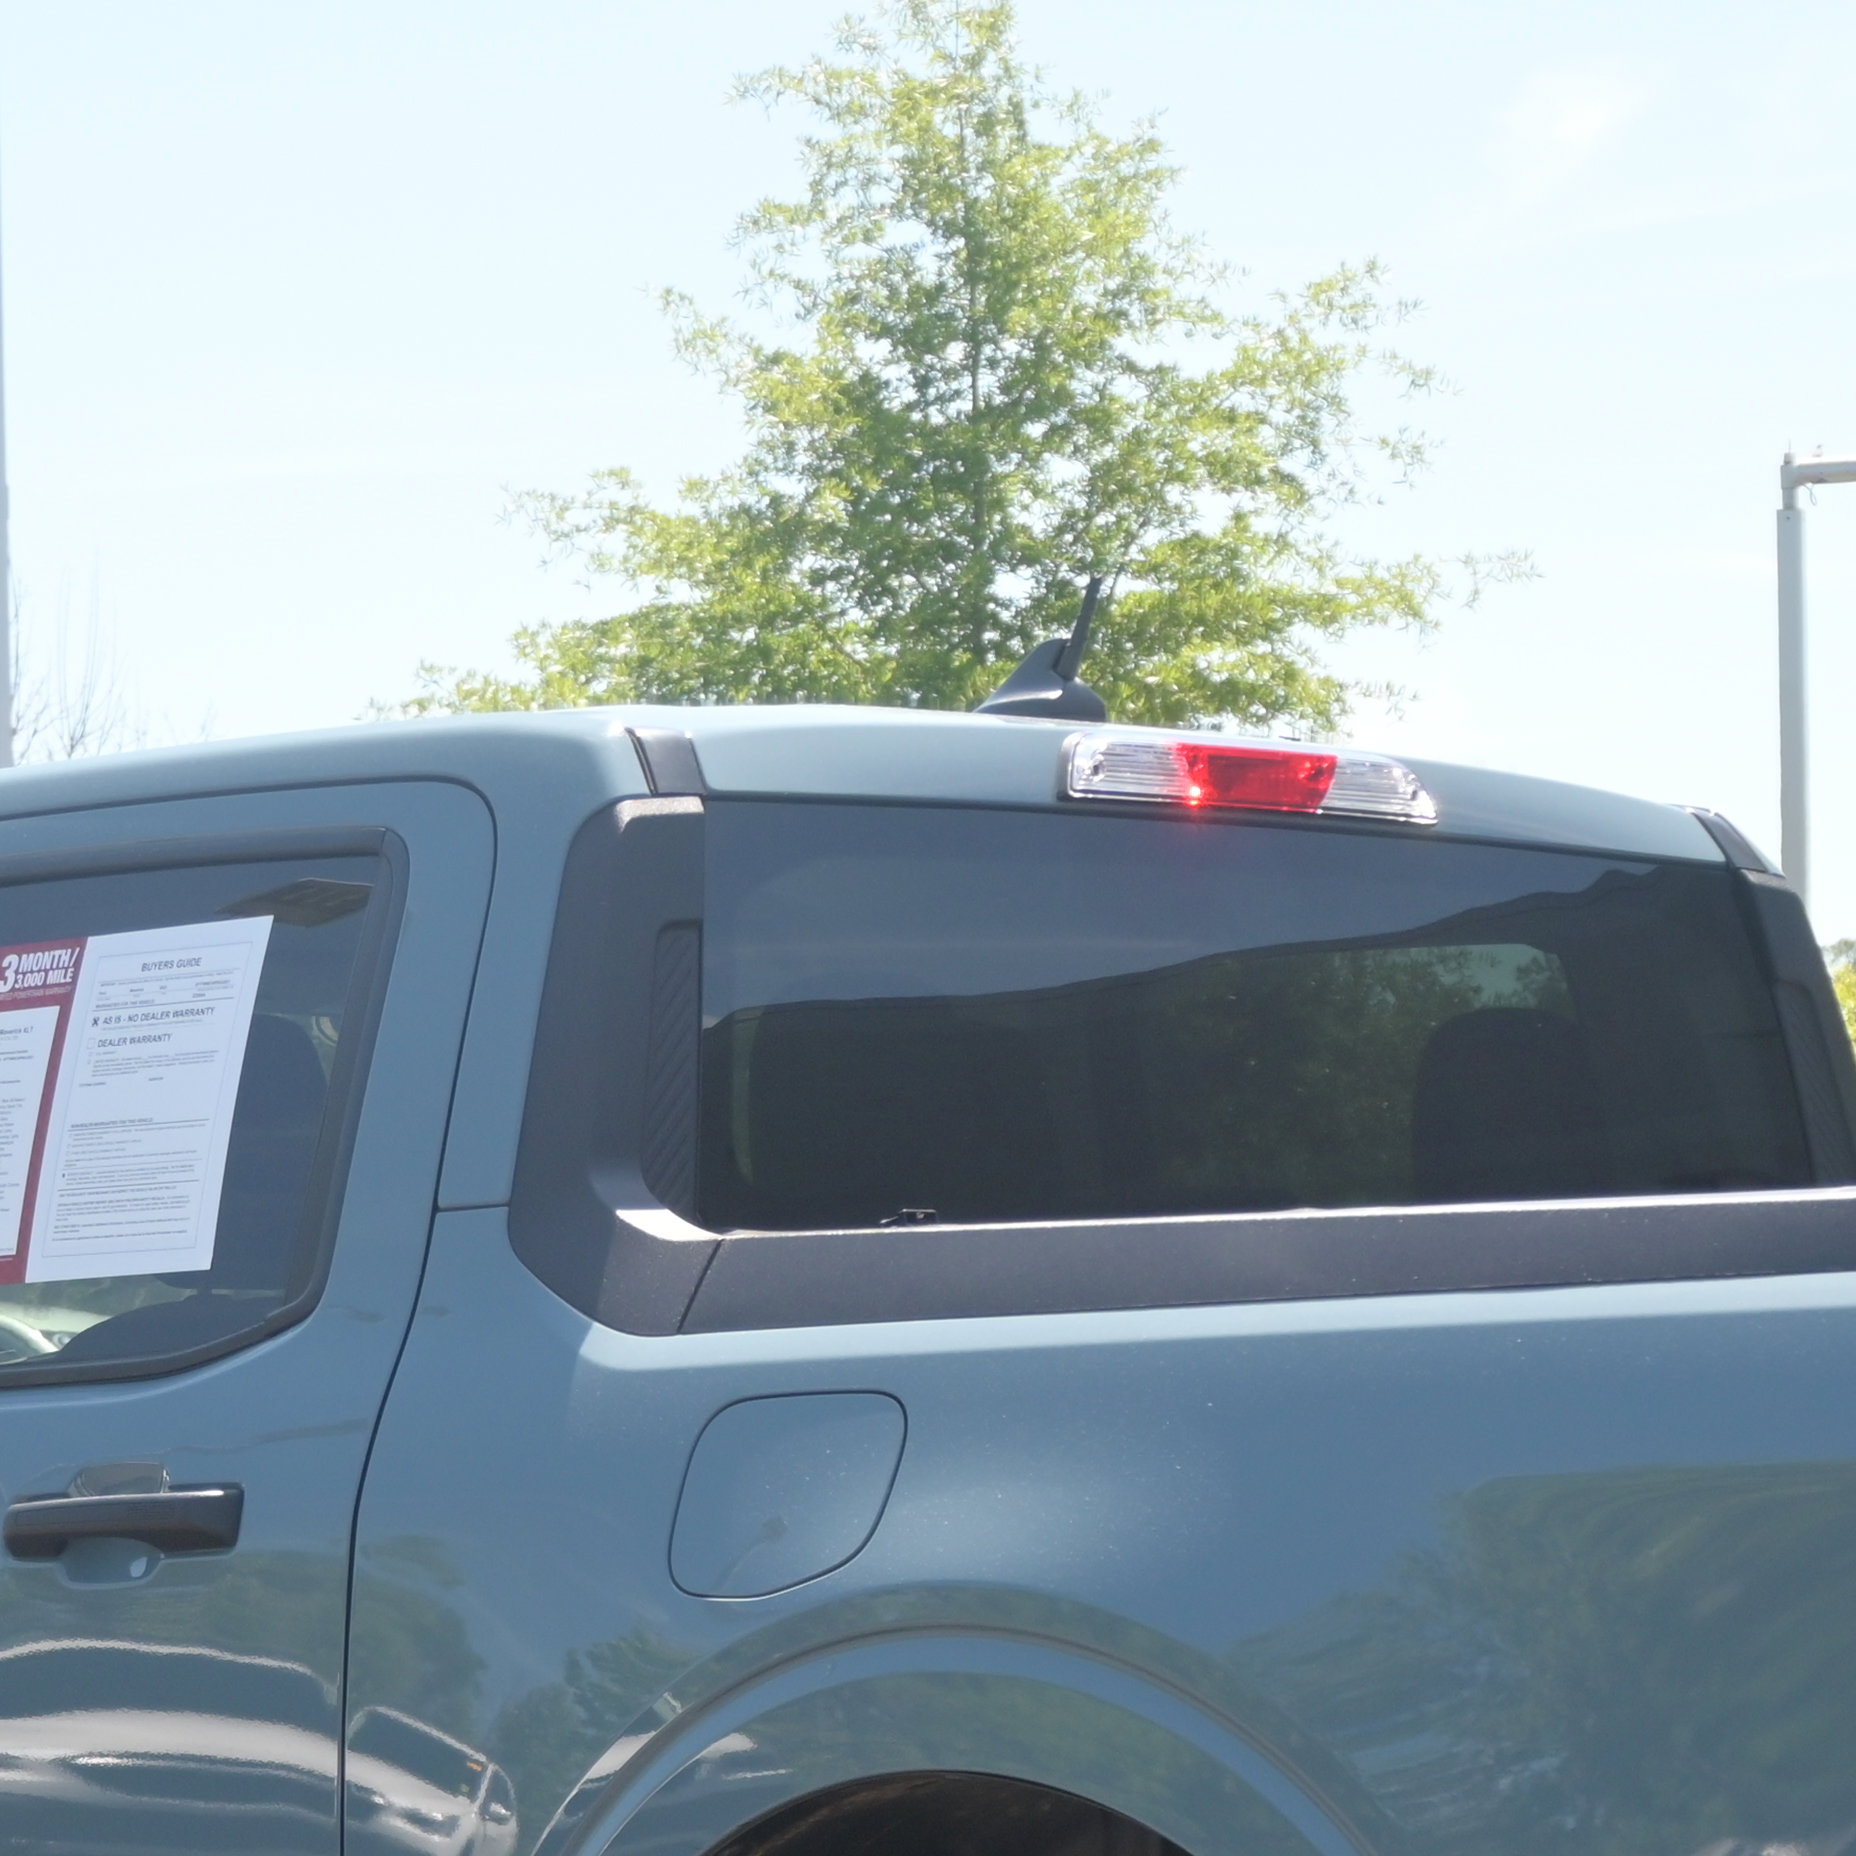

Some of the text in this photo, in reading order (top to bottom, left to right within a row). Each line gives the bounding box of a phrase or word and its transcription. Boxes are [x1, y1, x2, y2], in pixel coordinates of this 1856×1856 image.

[141, 957, 203, 972] BUYERS GUIDE
[14, 967, 75, 990] 3,000 MILE
[102, 1016, 113, 1025] AS
[114, 1015, 122, 1024] IS
[127, 1013, 139, 1023] NO
[140, 1010, 171, 1022] DEALER
[172, 1007, 216, 1018] WARRANTY
[97, 1034, 173, 1048] DEALER WARRANTY
